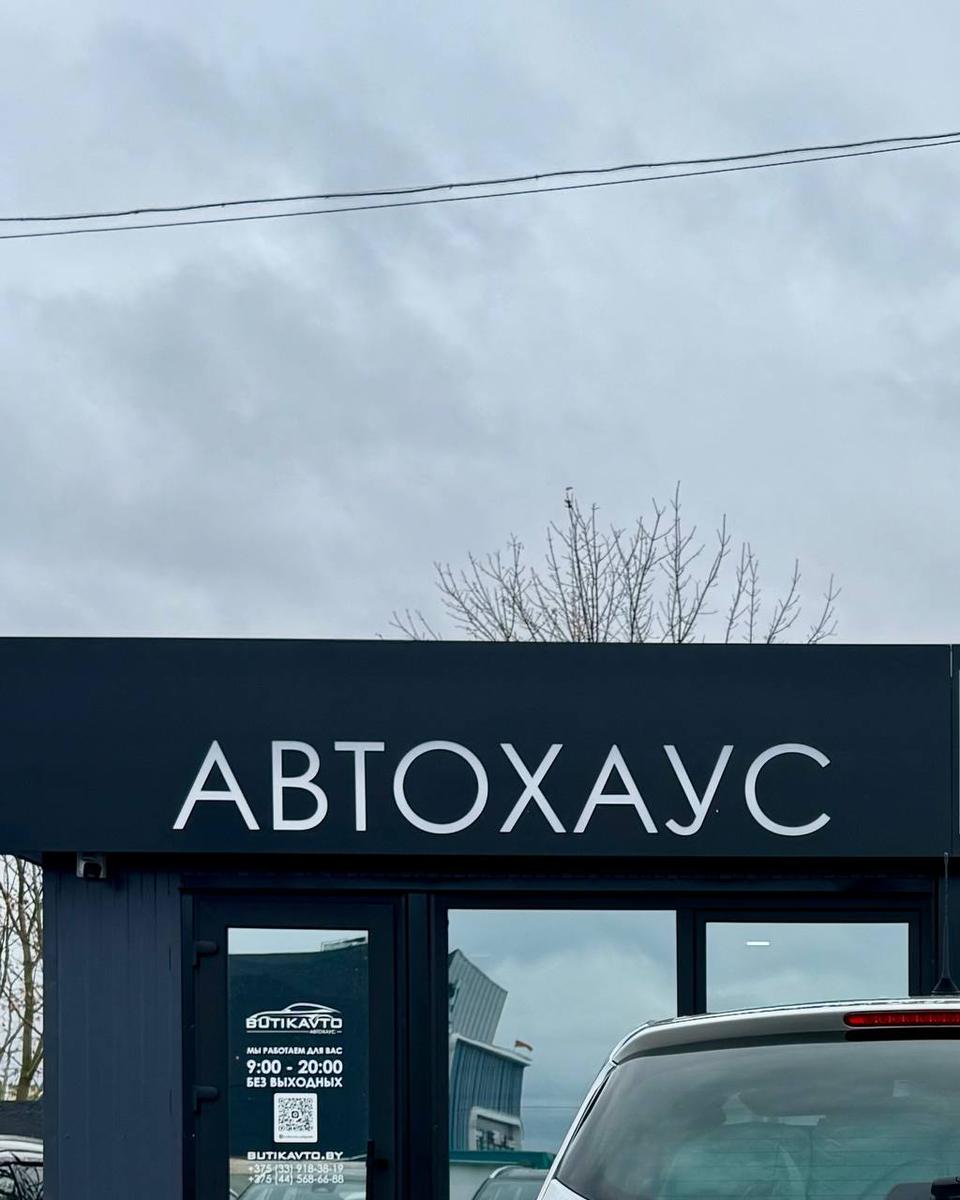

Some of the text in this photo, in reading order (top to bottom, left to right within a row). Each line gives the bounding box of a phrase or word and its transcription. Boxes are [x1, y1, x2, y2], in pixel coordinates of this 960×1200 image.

[172, 739, 831, 837] АВТОХАУС
[246, 1017, 342, 1029] BUTIKAVTO
[246, 1047, 343, 1055] МЫ РАБОТАЕМ ДЛЯ ВАС
[246, 1059, 281, 1074] 9:00
[298, 1059, 343, 1074] 20:00
[246, 1077, 343, 1089] БЕЗ ВЫХОДНЫХ
[247, 1151, 343, 1160] BUTIKAVTO.BY
[248, 1163, 344, 1175] +375 (33) 918-38-19
[248, 1174, 344, 1186] +375 (44) 568-66-88
